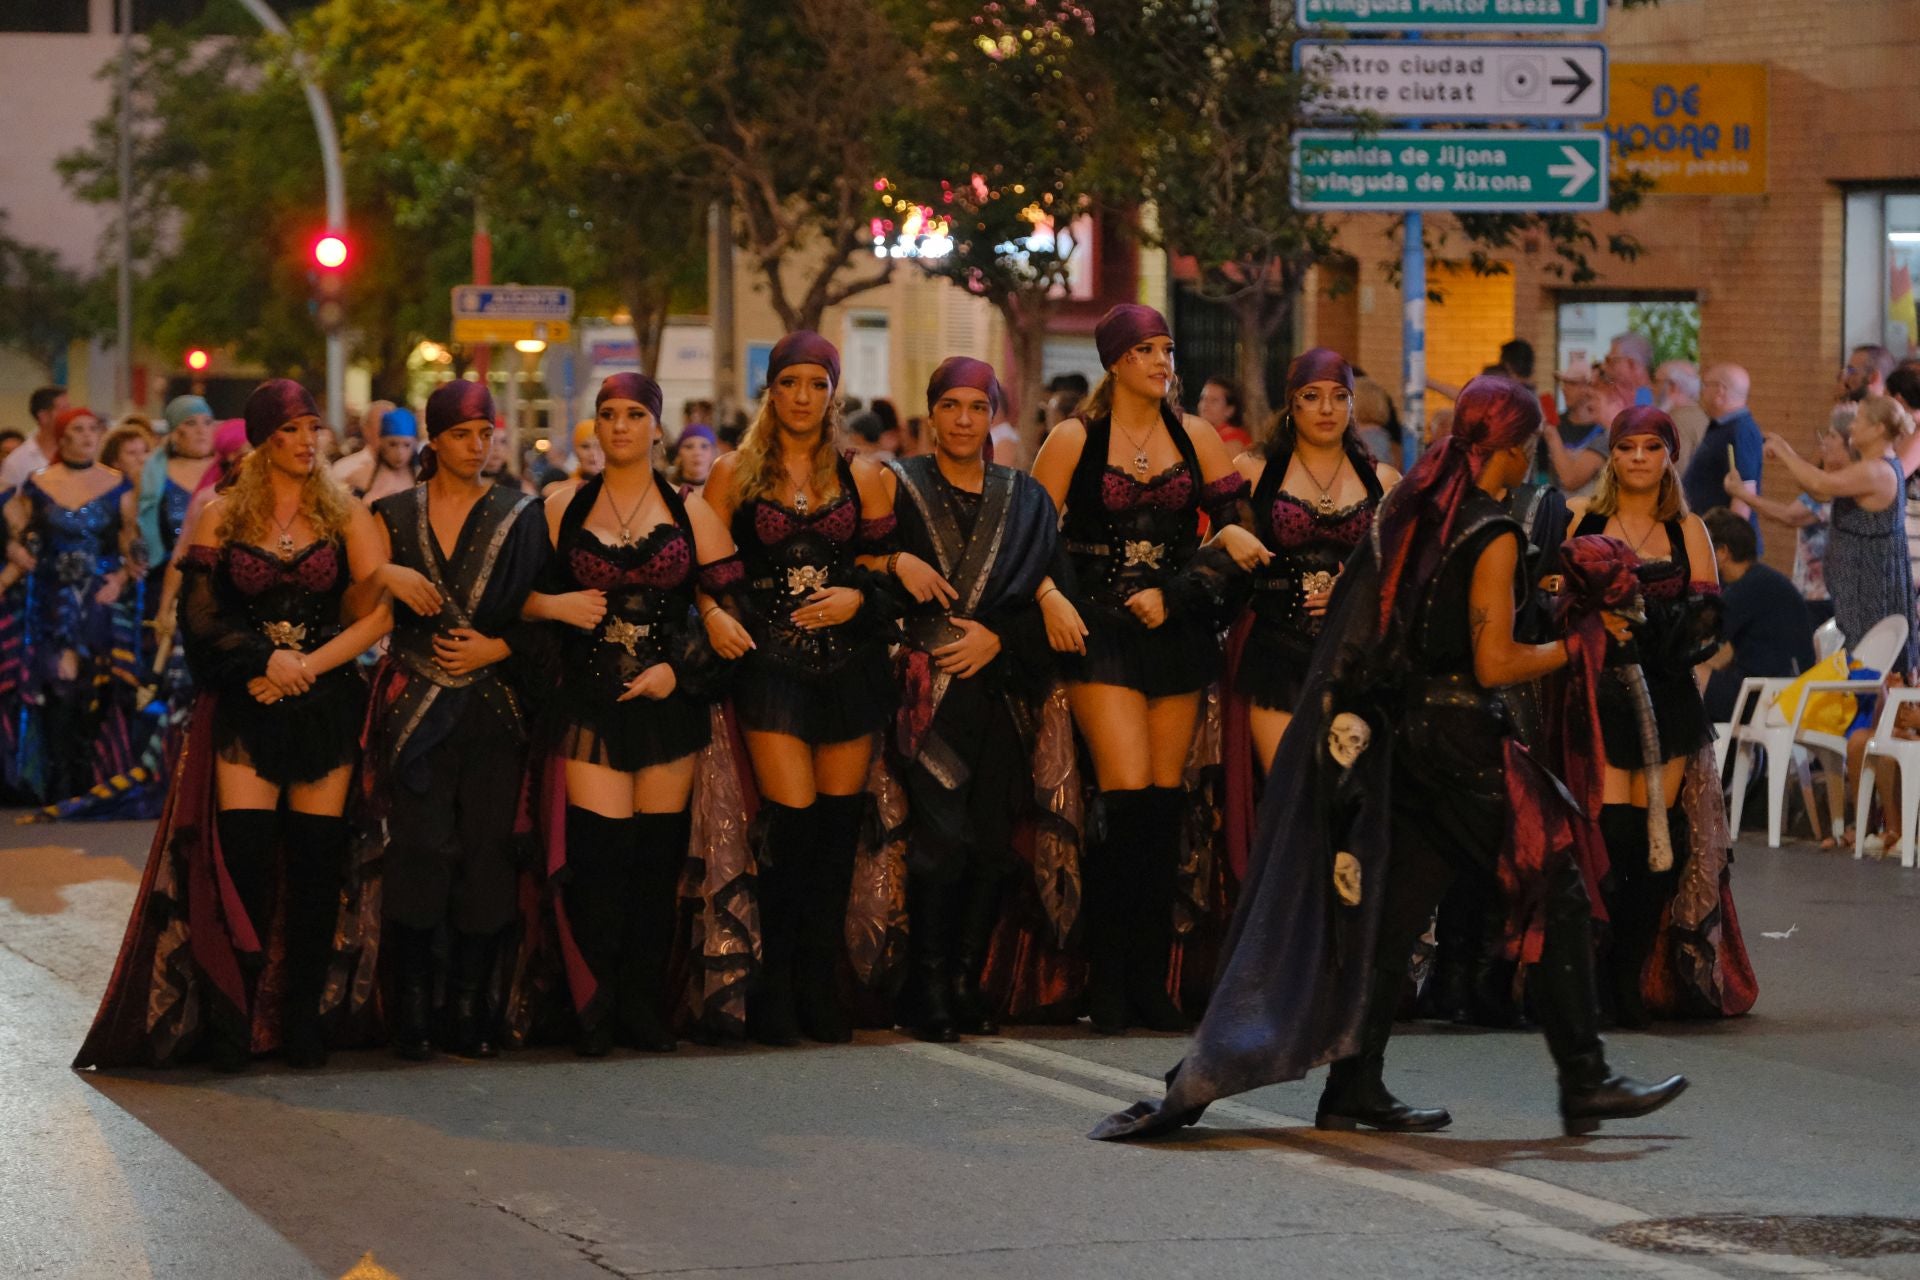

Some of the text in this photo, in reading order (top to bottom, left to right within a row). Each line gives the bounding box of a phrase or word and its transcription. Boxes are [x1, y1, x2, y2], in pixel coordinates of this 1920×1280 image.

[1400, 54, 1484, 75] ciudad
[1398, 81, 1475, 101] ciutat
[1653, 83, 1700, 117] DE
[1400, 146, 1430, 167] de
[1436, 145, 1507, 170] Jijona
[1415, 171, 1445, 192] de
[1453, 171, 1532, 192] Xixona
